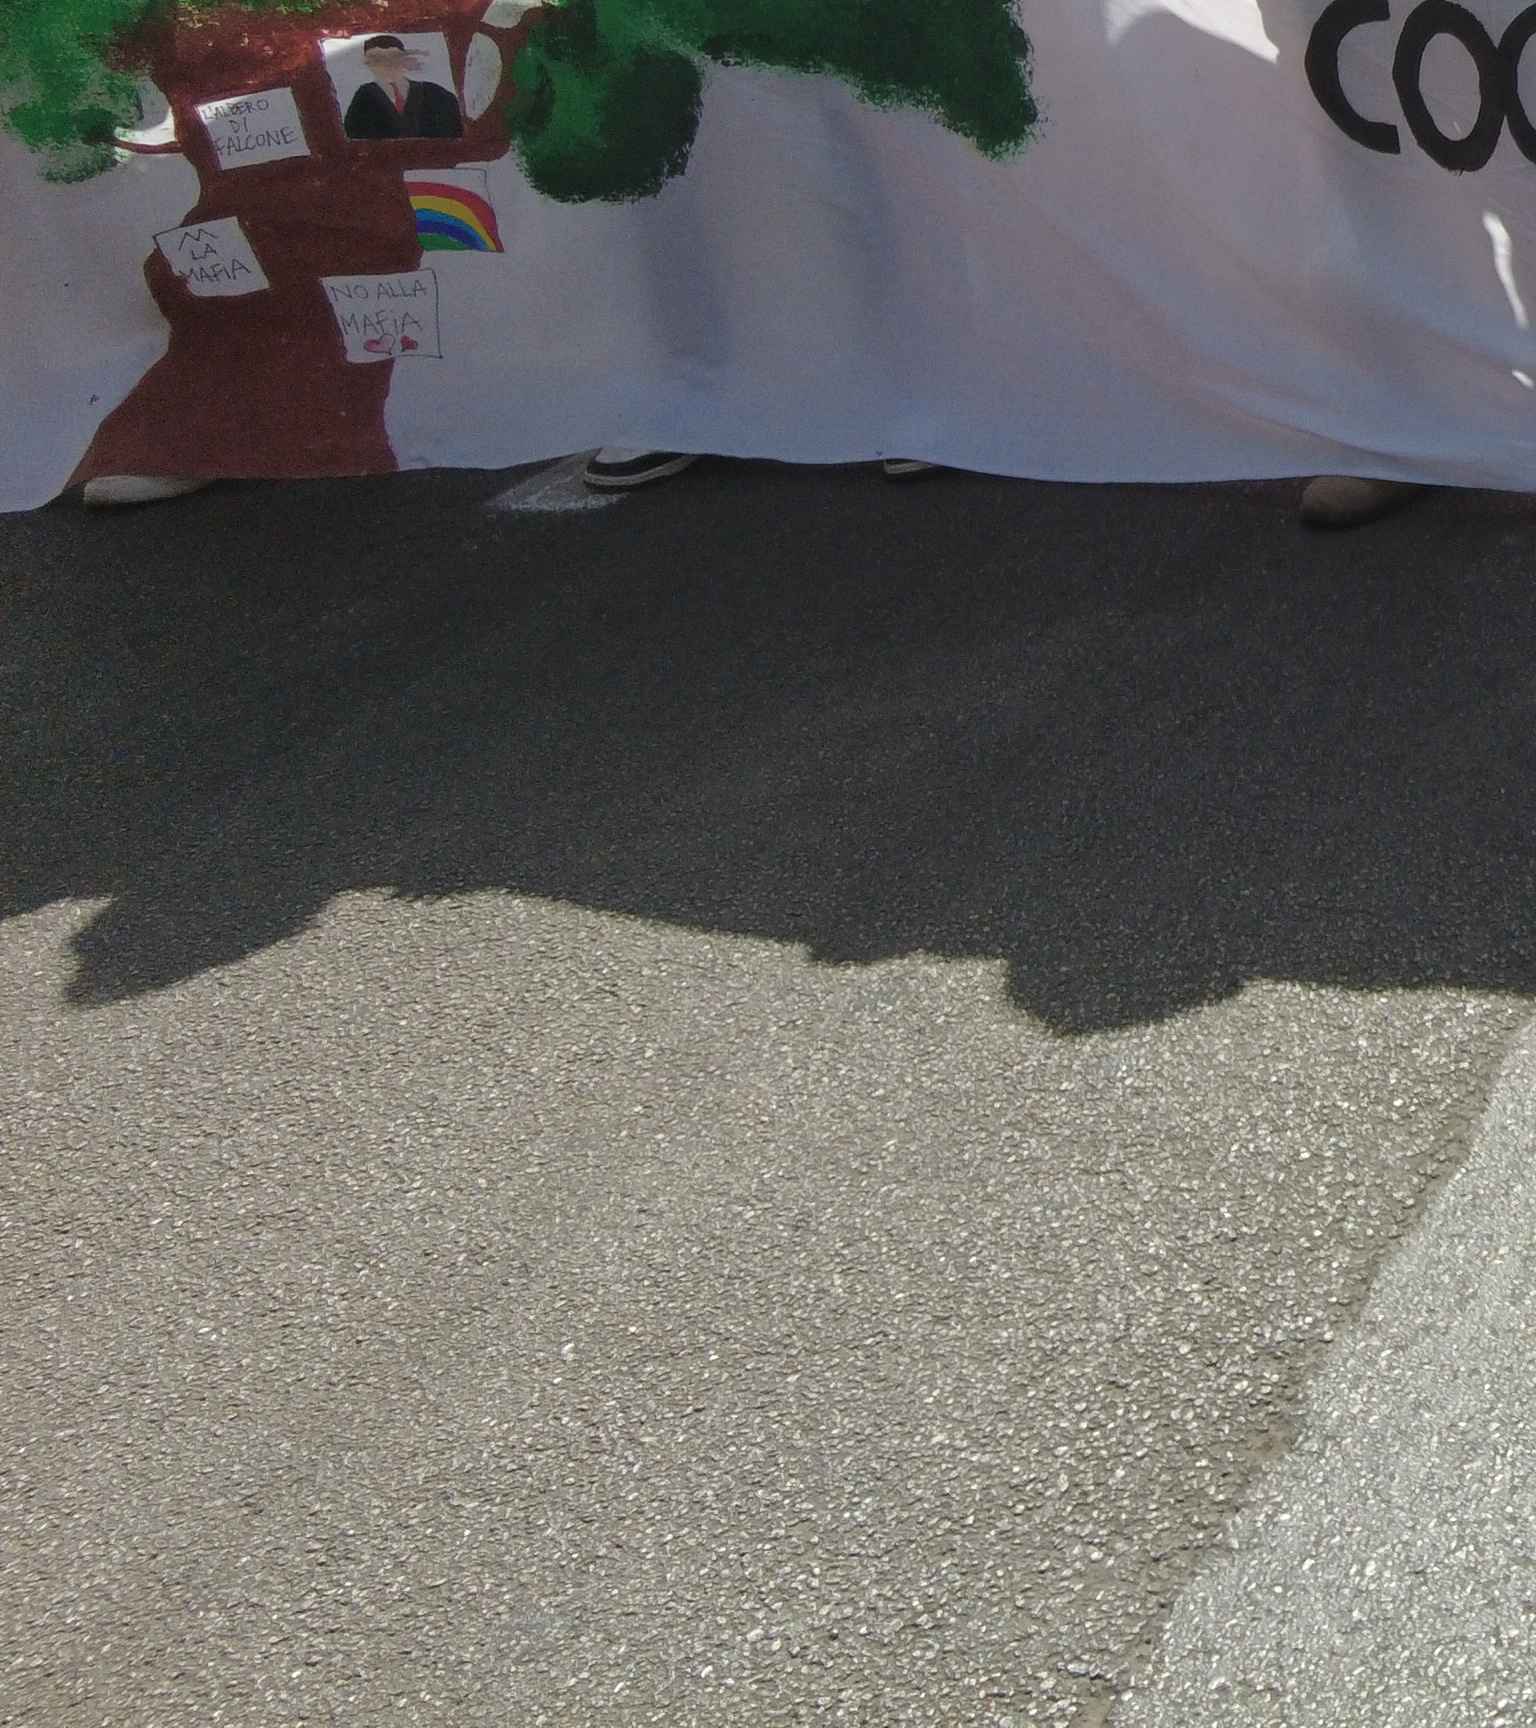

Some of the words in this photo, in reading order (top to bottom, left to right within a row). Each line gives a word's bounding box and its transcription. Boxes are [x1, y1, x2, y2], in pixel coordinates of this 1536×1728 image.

[229, 117, 248, 133] DI
[215, 126, 297, 156] FALCONE
[192, 243, 218, 260] LA
[178, 258, 251, 283] MAFIA
[330, 285, 368, 302] NO
[377, 279, 427, 300] ALLA
